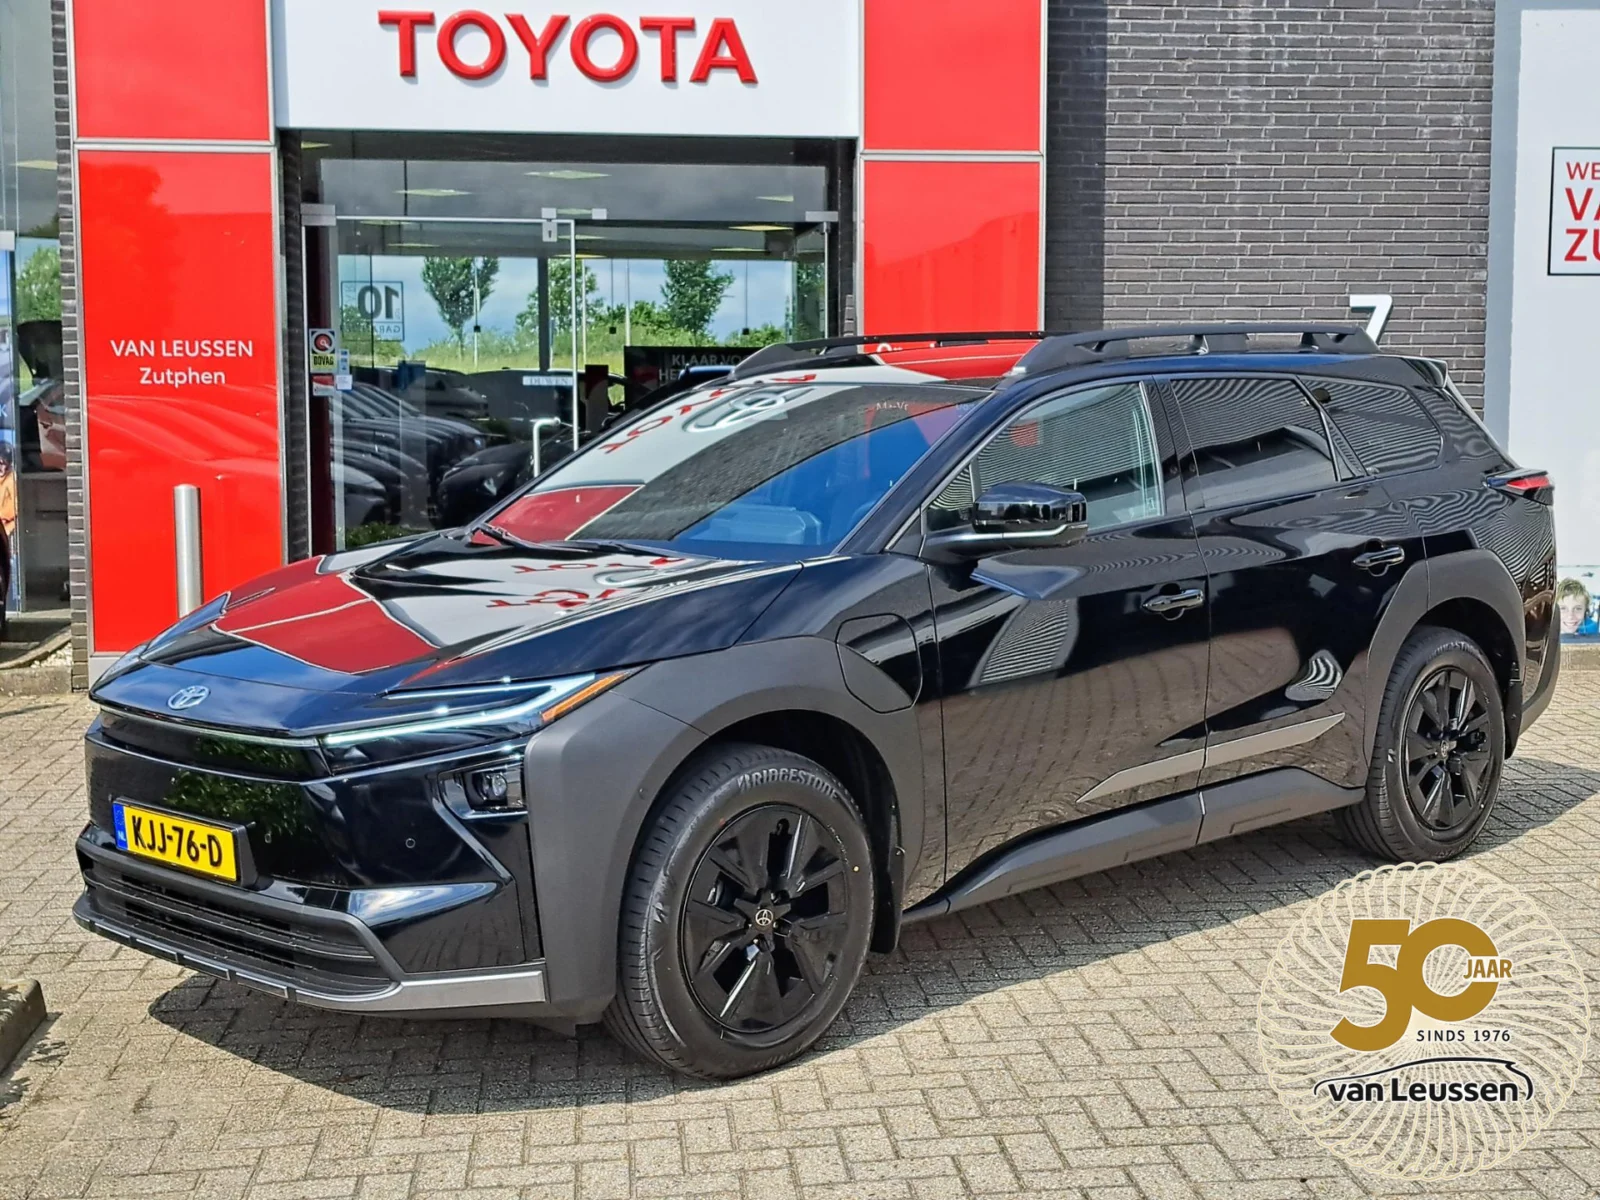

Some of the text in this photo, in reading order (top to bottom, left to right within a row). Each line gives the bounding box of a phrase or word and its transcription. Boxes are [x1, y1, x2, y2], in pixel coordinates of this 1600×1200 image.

[378, 10, 758, 84] TOYOTA
[1565, 188, 1600, 220] V
[1349, 294, 1393, 343] 7
[110, 340, 253, 357] VAN LEUSSEN
[672, 355, 717, 365] KLAAR
[139, 367, 226, 389] Zutphen
[737, 767, 839, 801] BRIDGESTONE
[132, 815, 223, 867] KJJ-76-D
